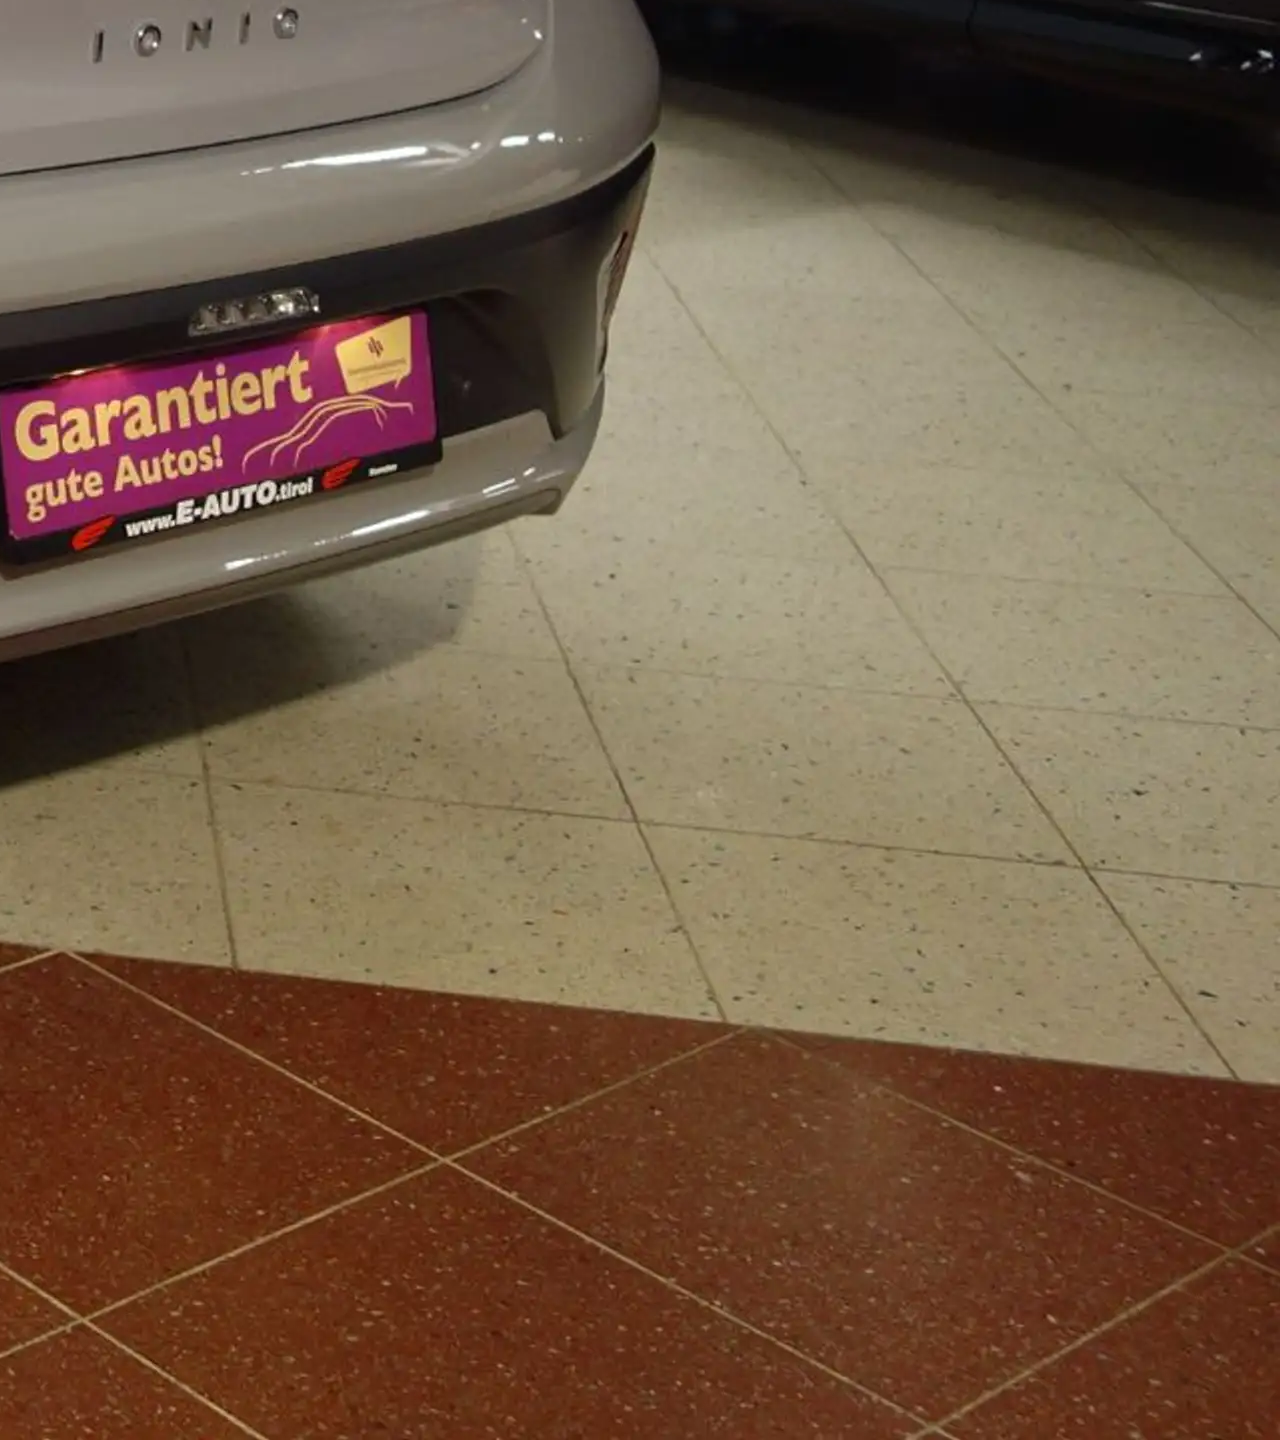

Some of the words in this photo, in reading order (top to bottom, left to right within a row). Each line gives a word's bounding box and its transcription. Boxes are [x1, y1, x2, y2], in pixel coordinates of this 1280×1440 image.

[14, 350, 313, 462] Garantiert
[24, 467, 104, 524] gute
[113, 433, 224, 493] Autos!
[125, 476, 314, 538] www.E-AUTO.tirol
